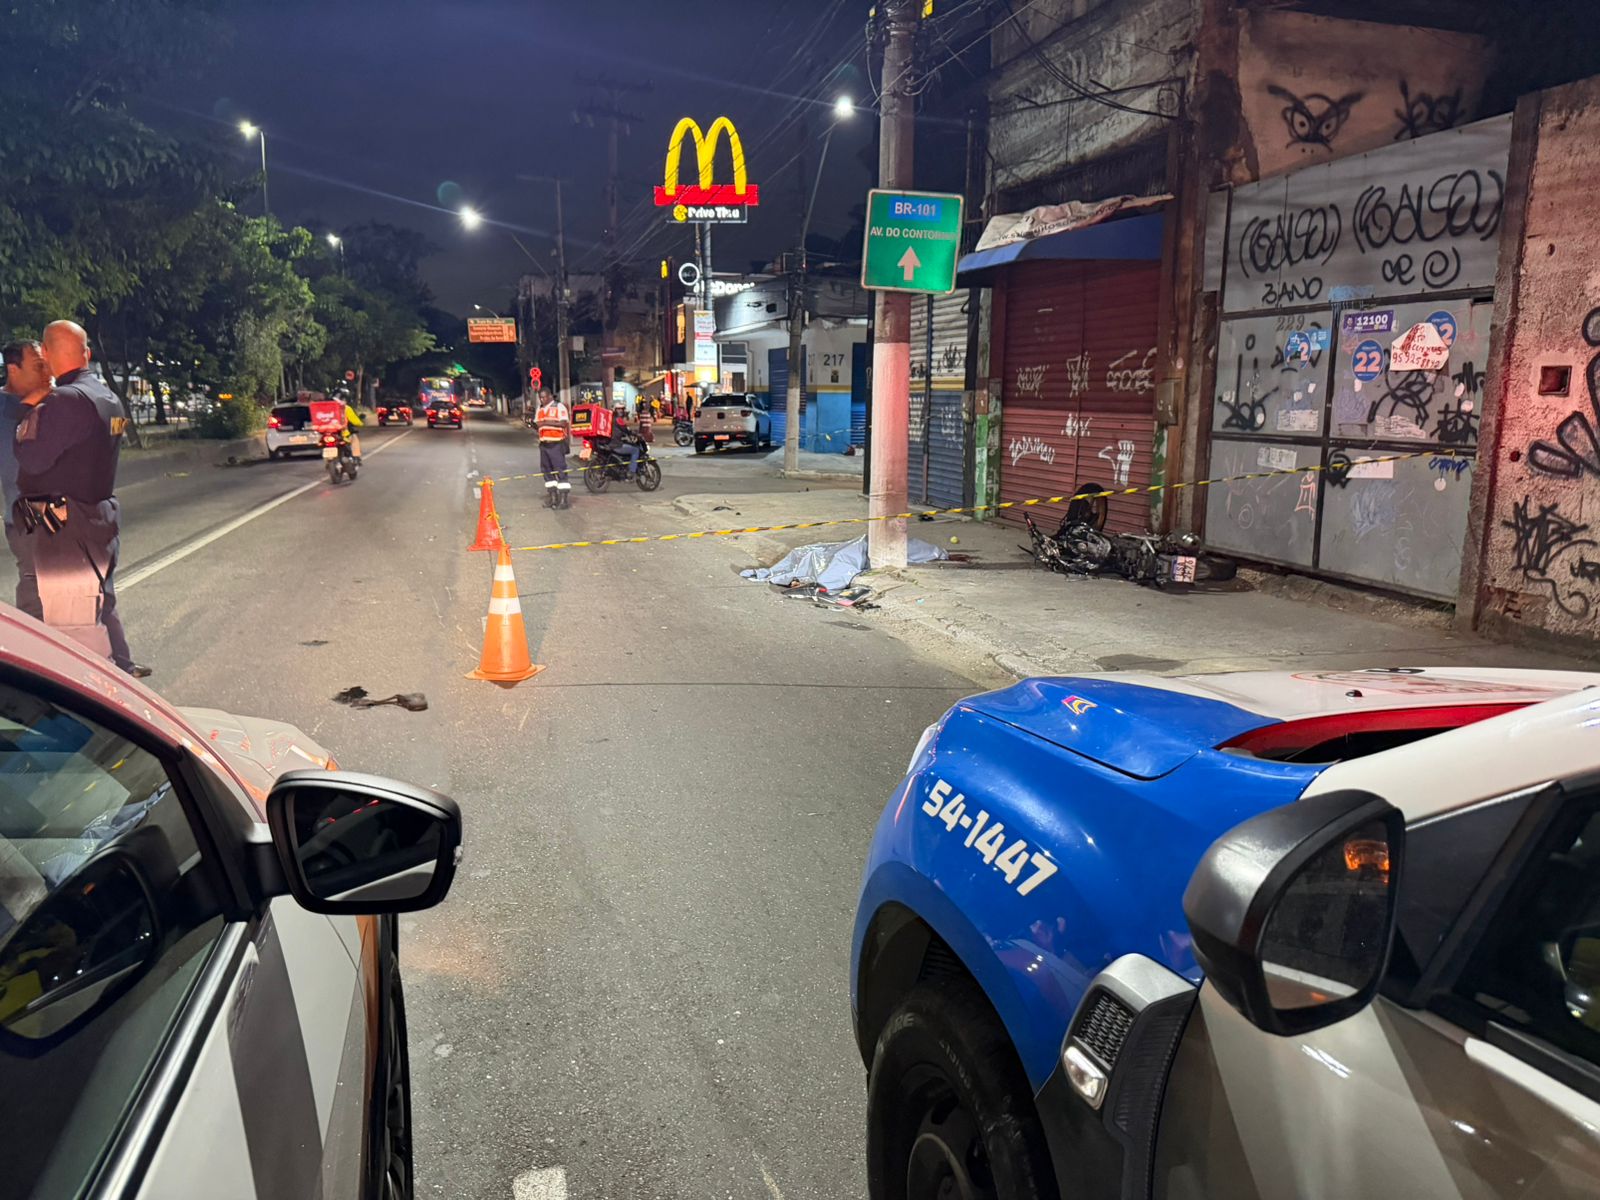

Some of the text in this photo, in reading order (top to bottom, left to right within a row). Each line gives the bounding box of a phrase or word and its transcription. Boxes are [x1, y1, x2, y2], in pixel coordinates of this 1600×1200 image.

[895, 202, 936, 216] BR-101
[870, 226, 883, 236] AV.
[886, 227, 900, 237] DO
[1356, 314, 1389, 326] 12100
[824, 353, 845, 367] 217
[1354, 351, 1381, 373] 22
[922, 779, 1058, 896] 54-1447
